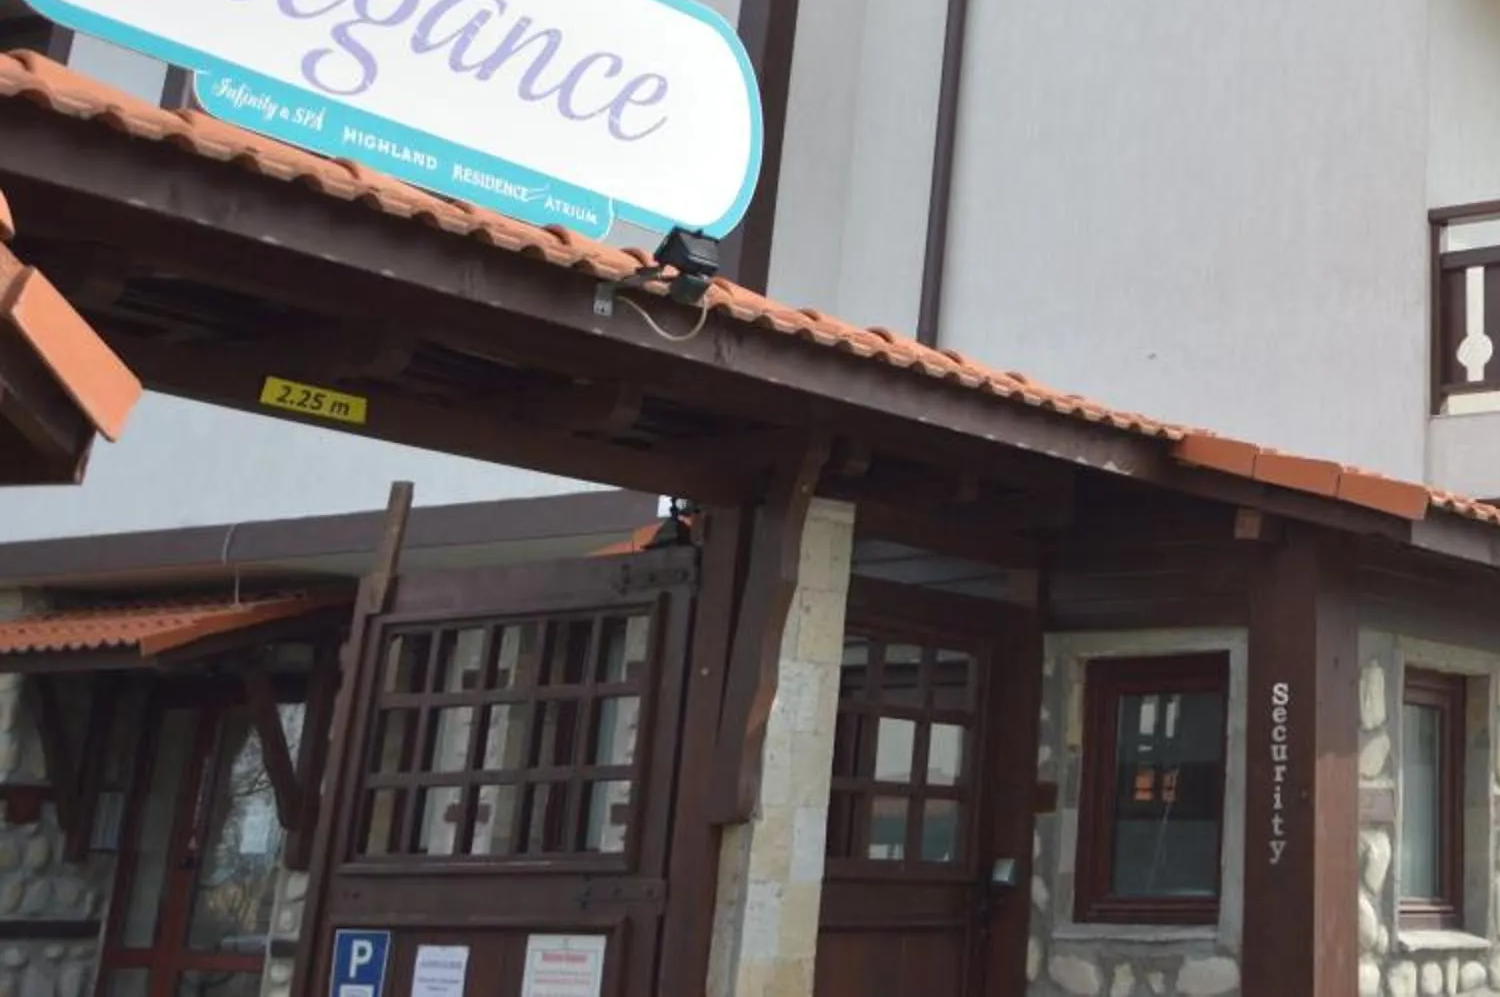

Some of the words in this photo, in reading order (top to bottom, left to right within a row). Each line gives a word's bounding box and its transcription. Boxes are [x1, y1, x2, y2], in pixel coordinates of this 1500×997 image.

[290, 106, 326, 131] SPA
[343, 126, 438, 171] HIGHLAND
[452, 163, 530, 203] RESIDENCE
[544, 195, 598, 226] ATRIUM
[276, 384, 327, 411] 2.25
[329, 400, 350, 416] m
[1268, 682, 1290, 864] Security
[349, 939, 373, 979] P
